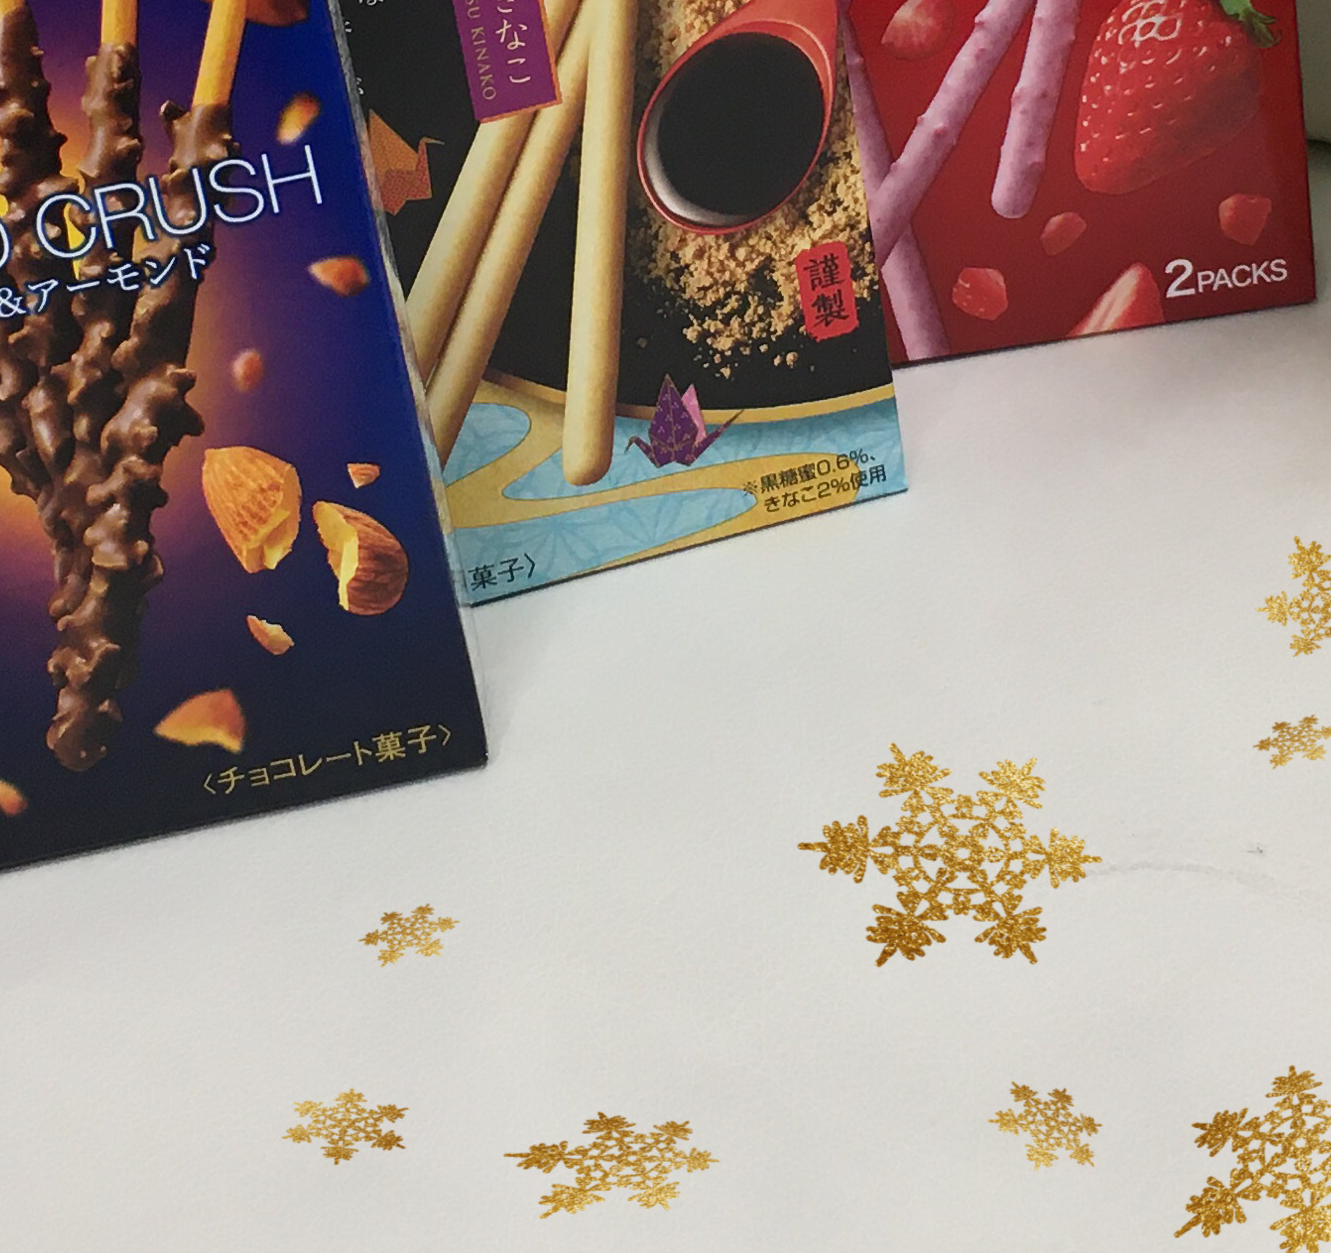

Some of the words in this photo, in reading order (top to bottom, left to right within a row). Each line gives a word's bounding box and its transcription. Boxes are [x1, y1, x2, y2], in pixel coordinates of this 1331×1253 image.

[471, 26, 497, 100] KINAKO
[35, 144, 323, 259] CRUSH
[803, 253, 849, 327] 謹製
